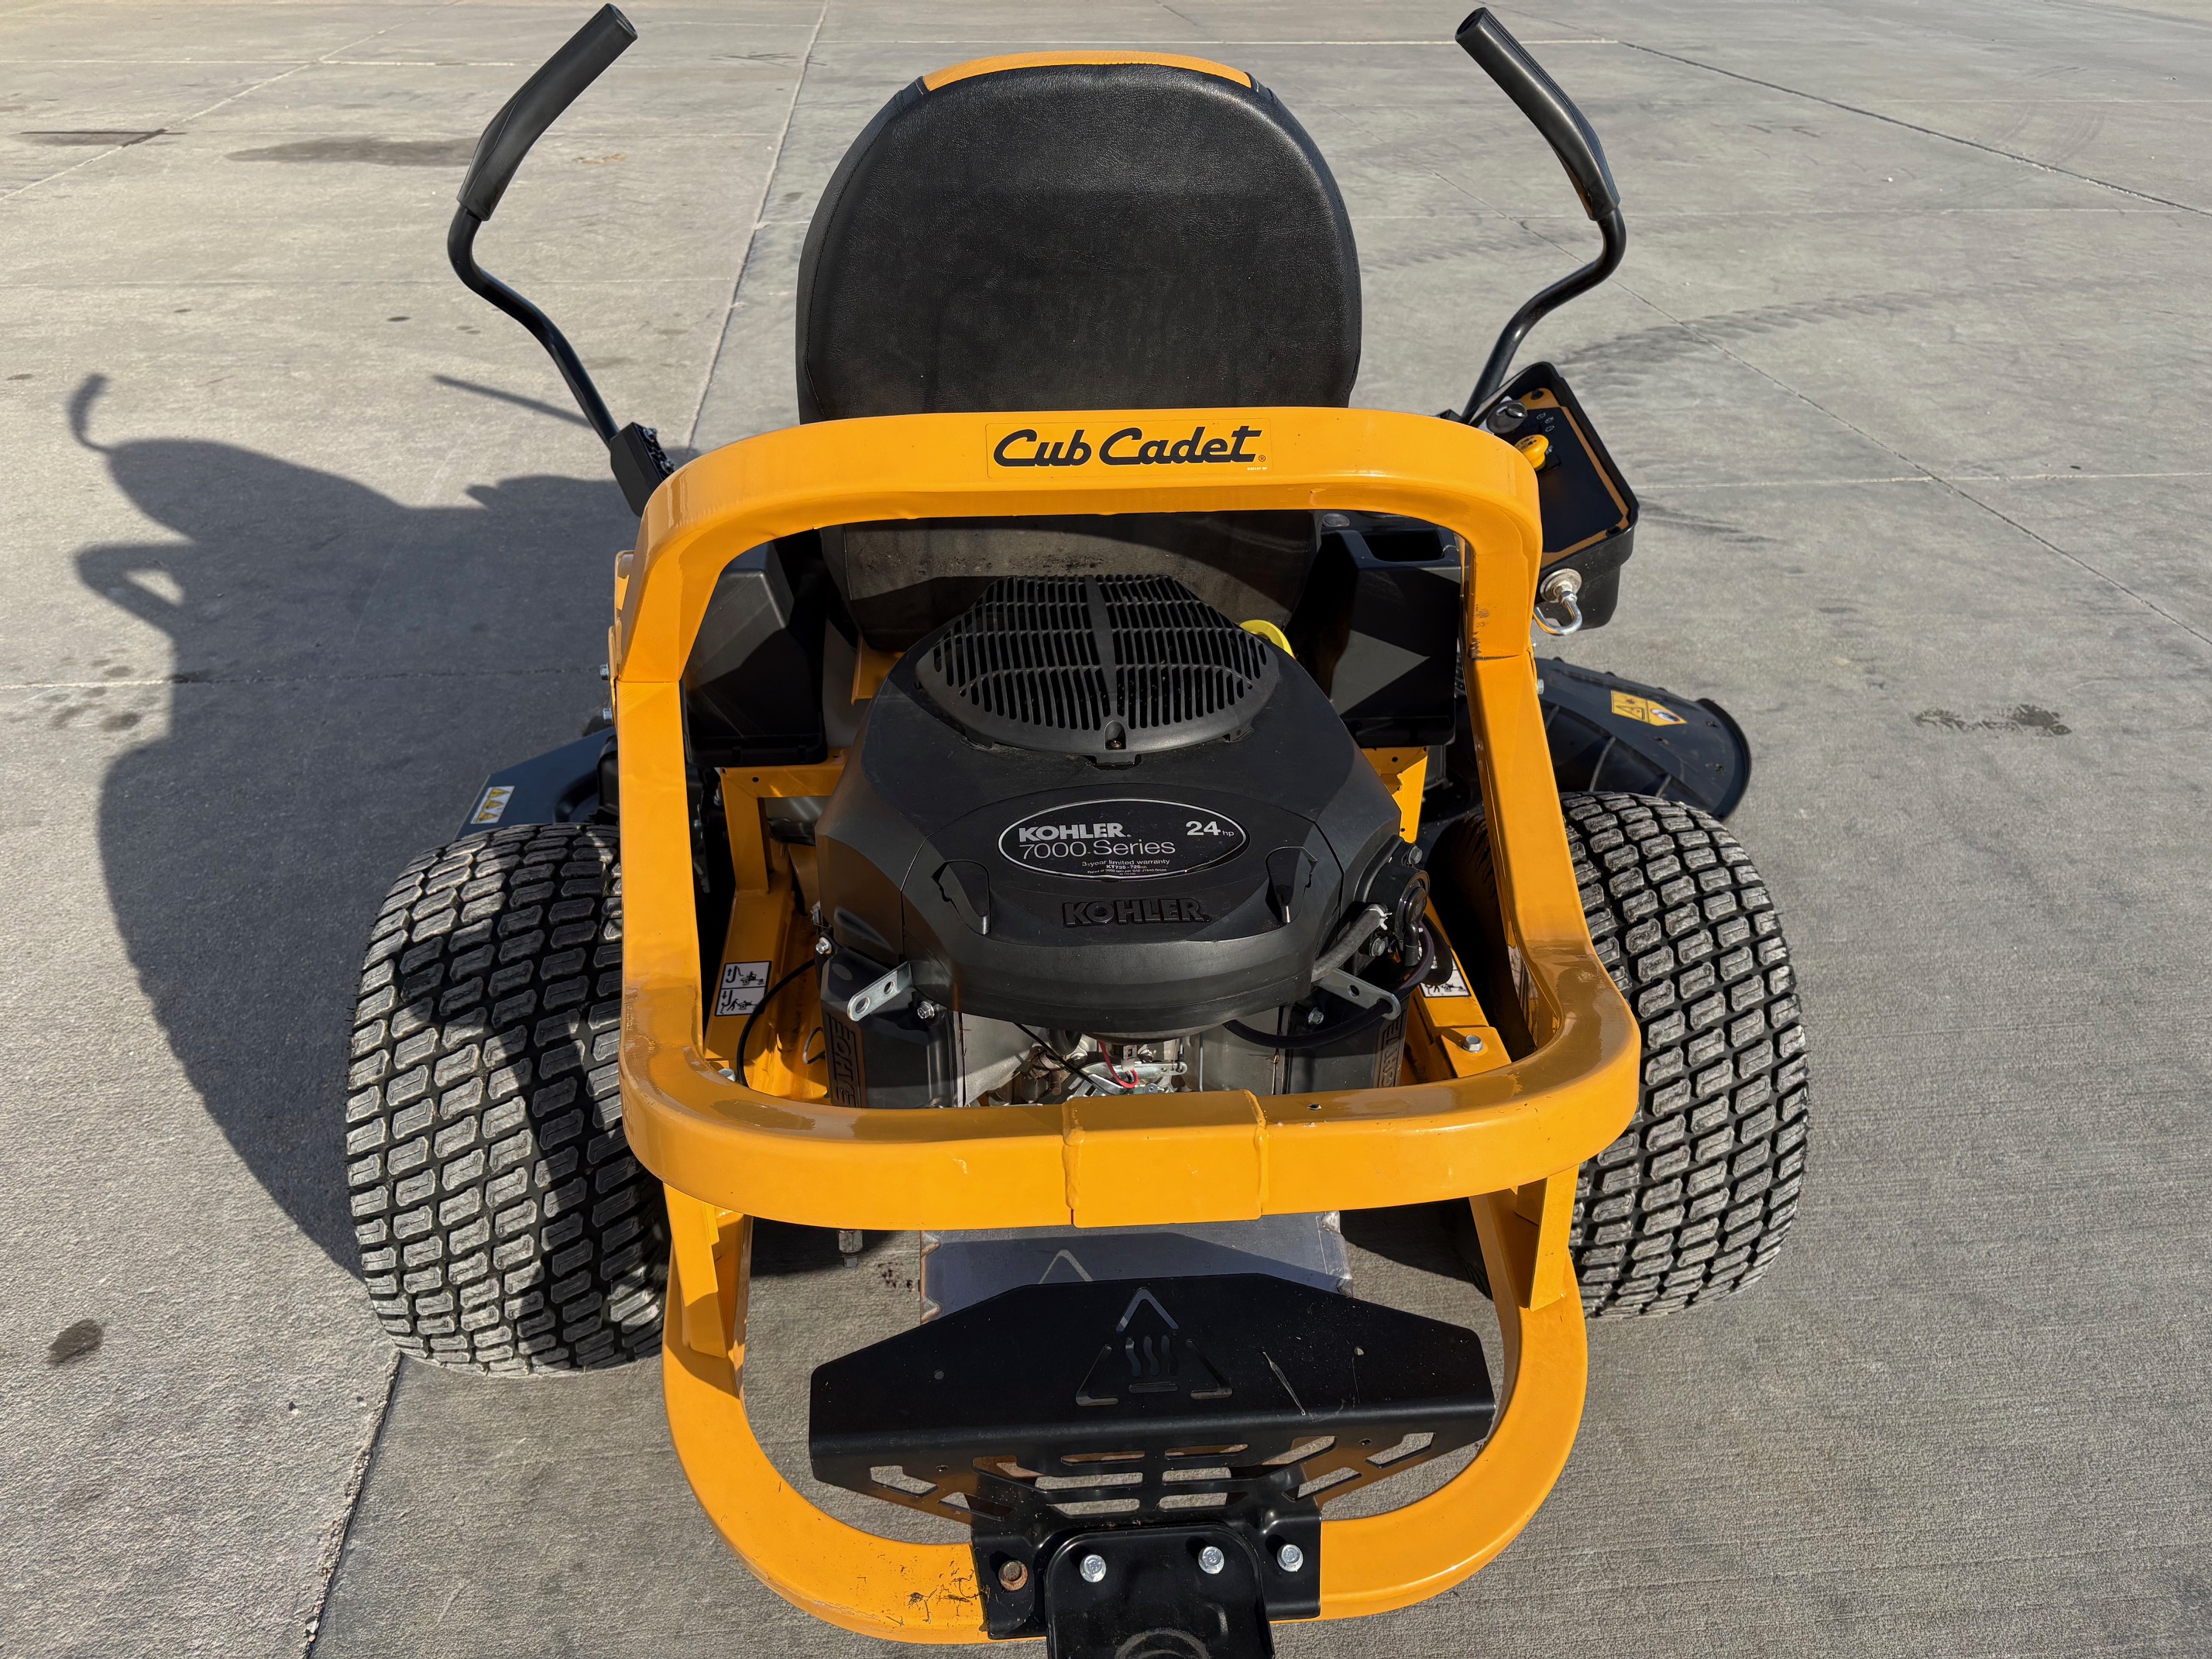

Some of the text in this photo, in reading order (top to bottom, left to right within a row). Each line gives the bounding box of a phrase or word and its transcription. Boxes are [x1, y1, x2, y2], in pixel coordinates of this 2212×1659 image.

[993, 425, 1263, 467] Cub Cadet
[1018, 839, 1176, 860] 7000 Series
